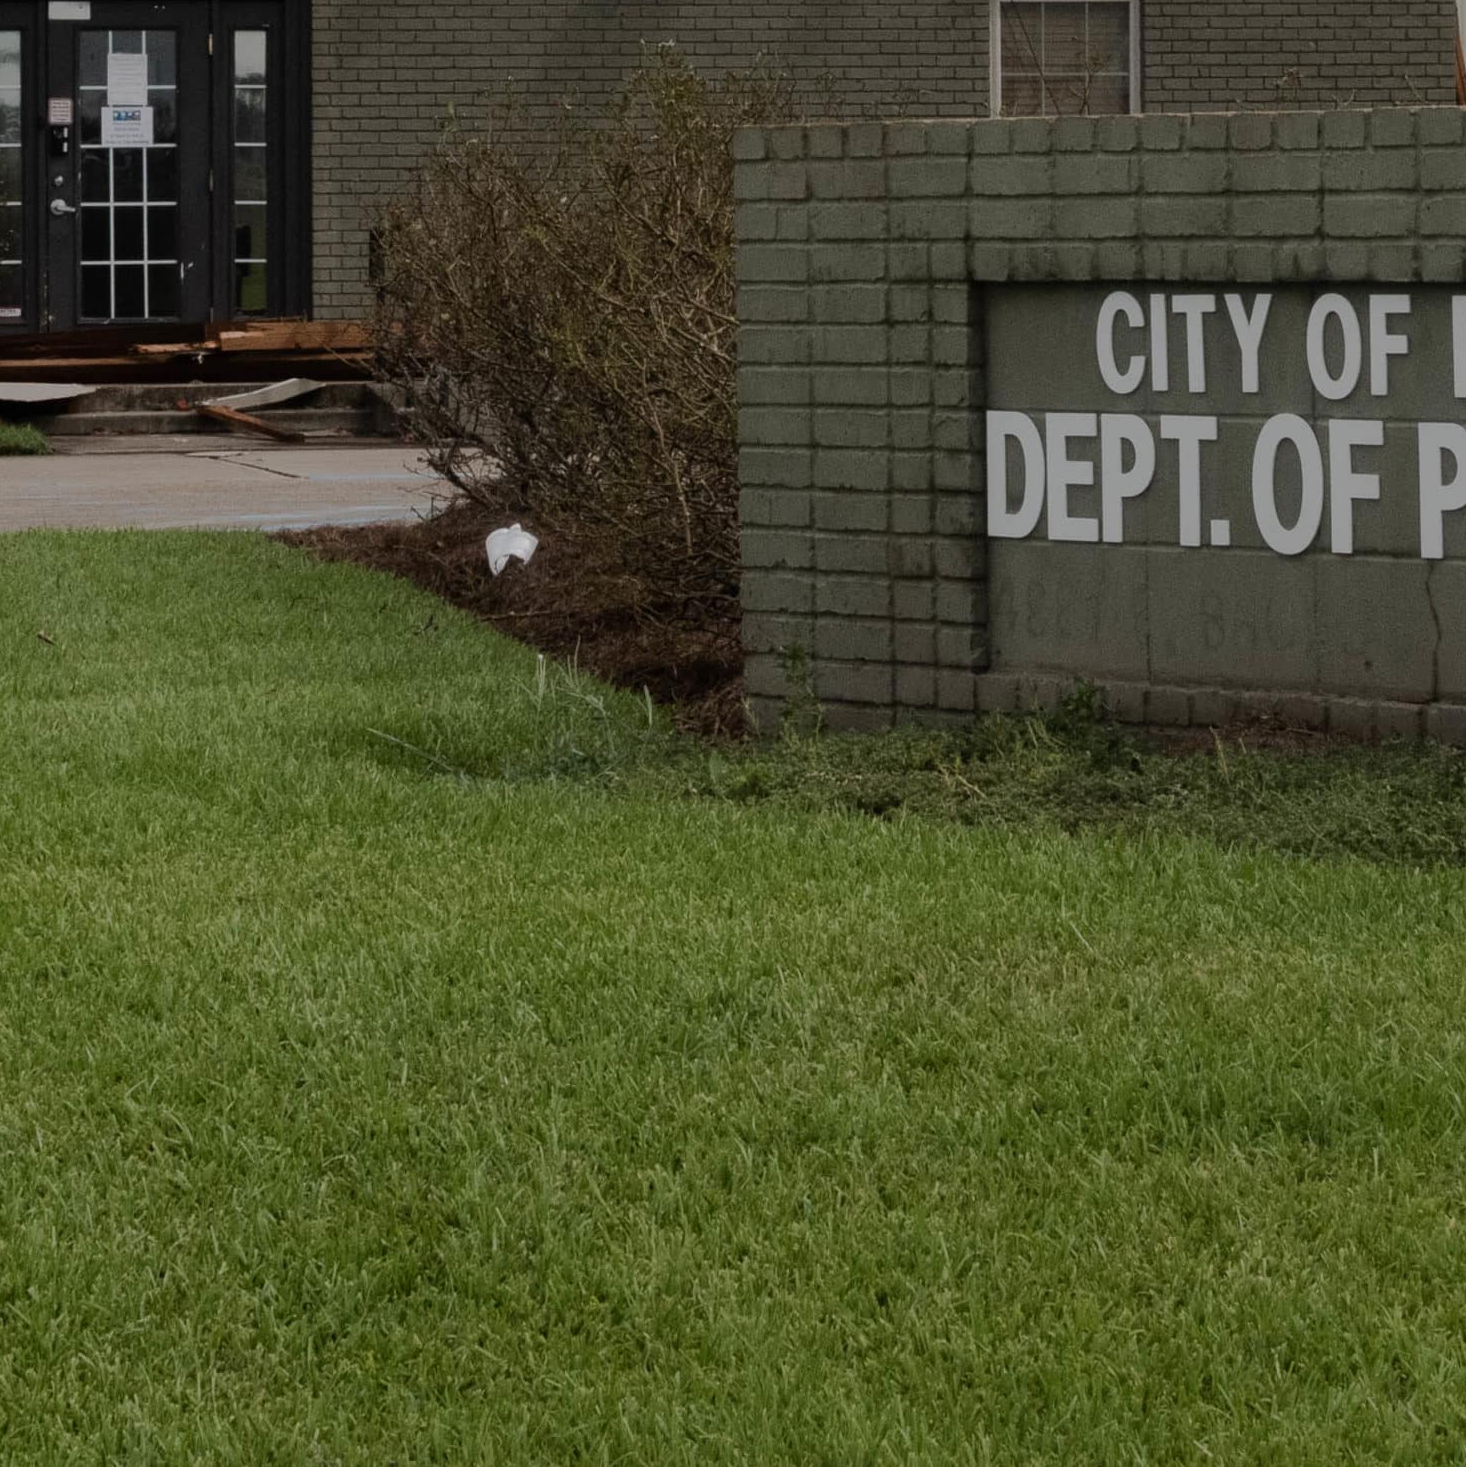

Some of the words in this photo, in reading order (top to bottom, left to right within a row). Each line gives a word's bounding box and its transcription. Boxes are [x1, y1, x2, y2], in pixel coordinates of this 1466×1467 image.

[1096, 291, 1272, 394] CITY
[1306, 293, 1411, 400] OF
[986, 410, 1231, 547] DEPT.
[1251, 412, 1384, 555] OF
